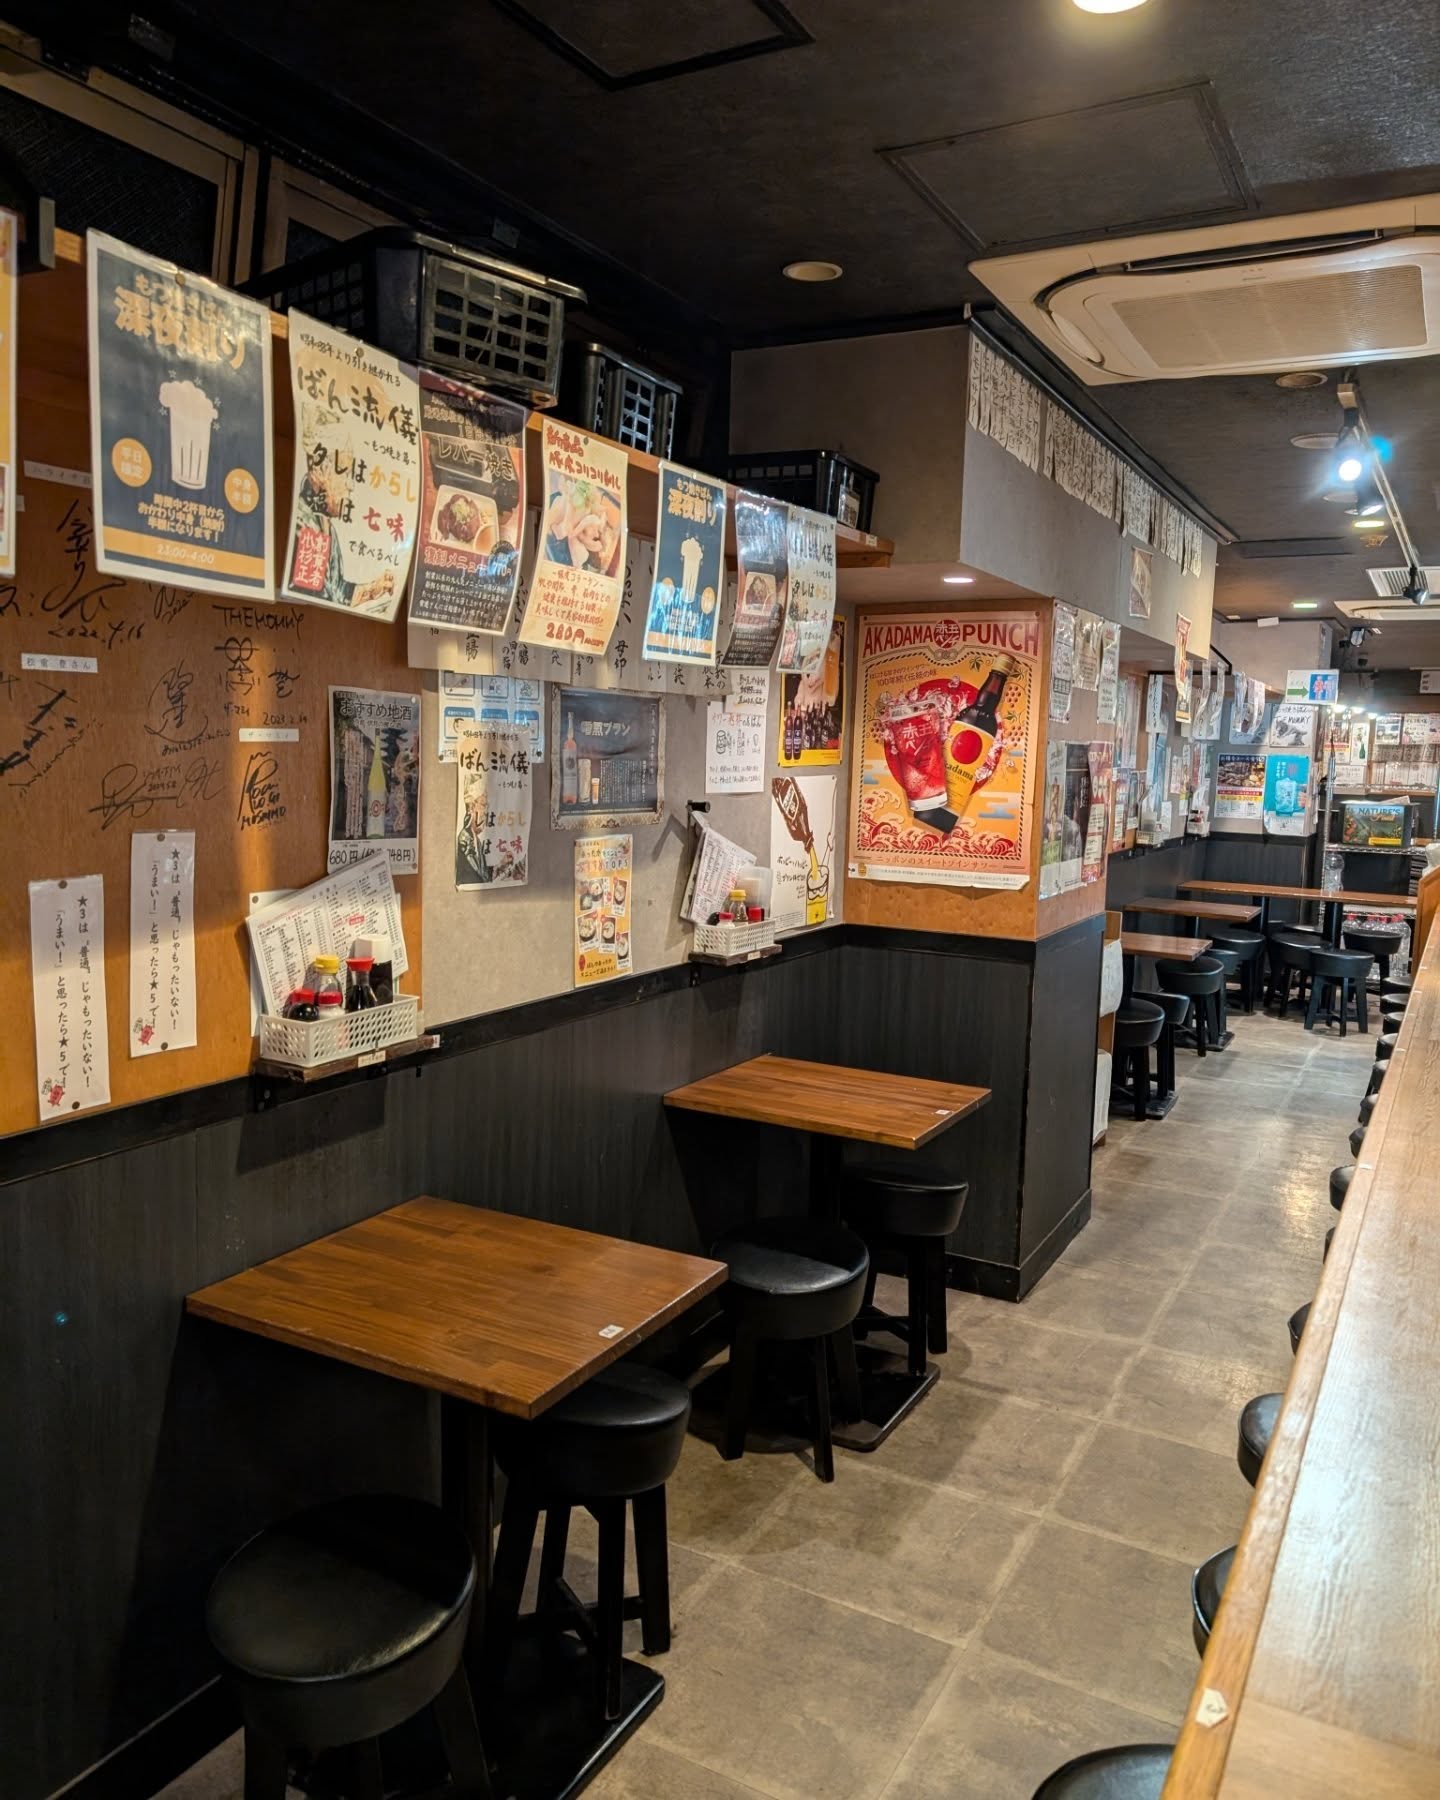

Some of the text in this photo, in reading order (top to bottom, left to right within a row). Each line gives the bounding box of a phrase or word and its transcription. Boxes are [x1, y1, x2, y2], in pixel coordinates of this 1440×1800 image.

[297, 366, 420, 446] ばん流儀
[862, 624, 934, 659] AKADAMA
[962, 623, 1040, 657] PUNCH
[339, 700, 413, 722] おすすめ地酒
[876, 855, 999, 870] ニッポンのスイートワインサワー
